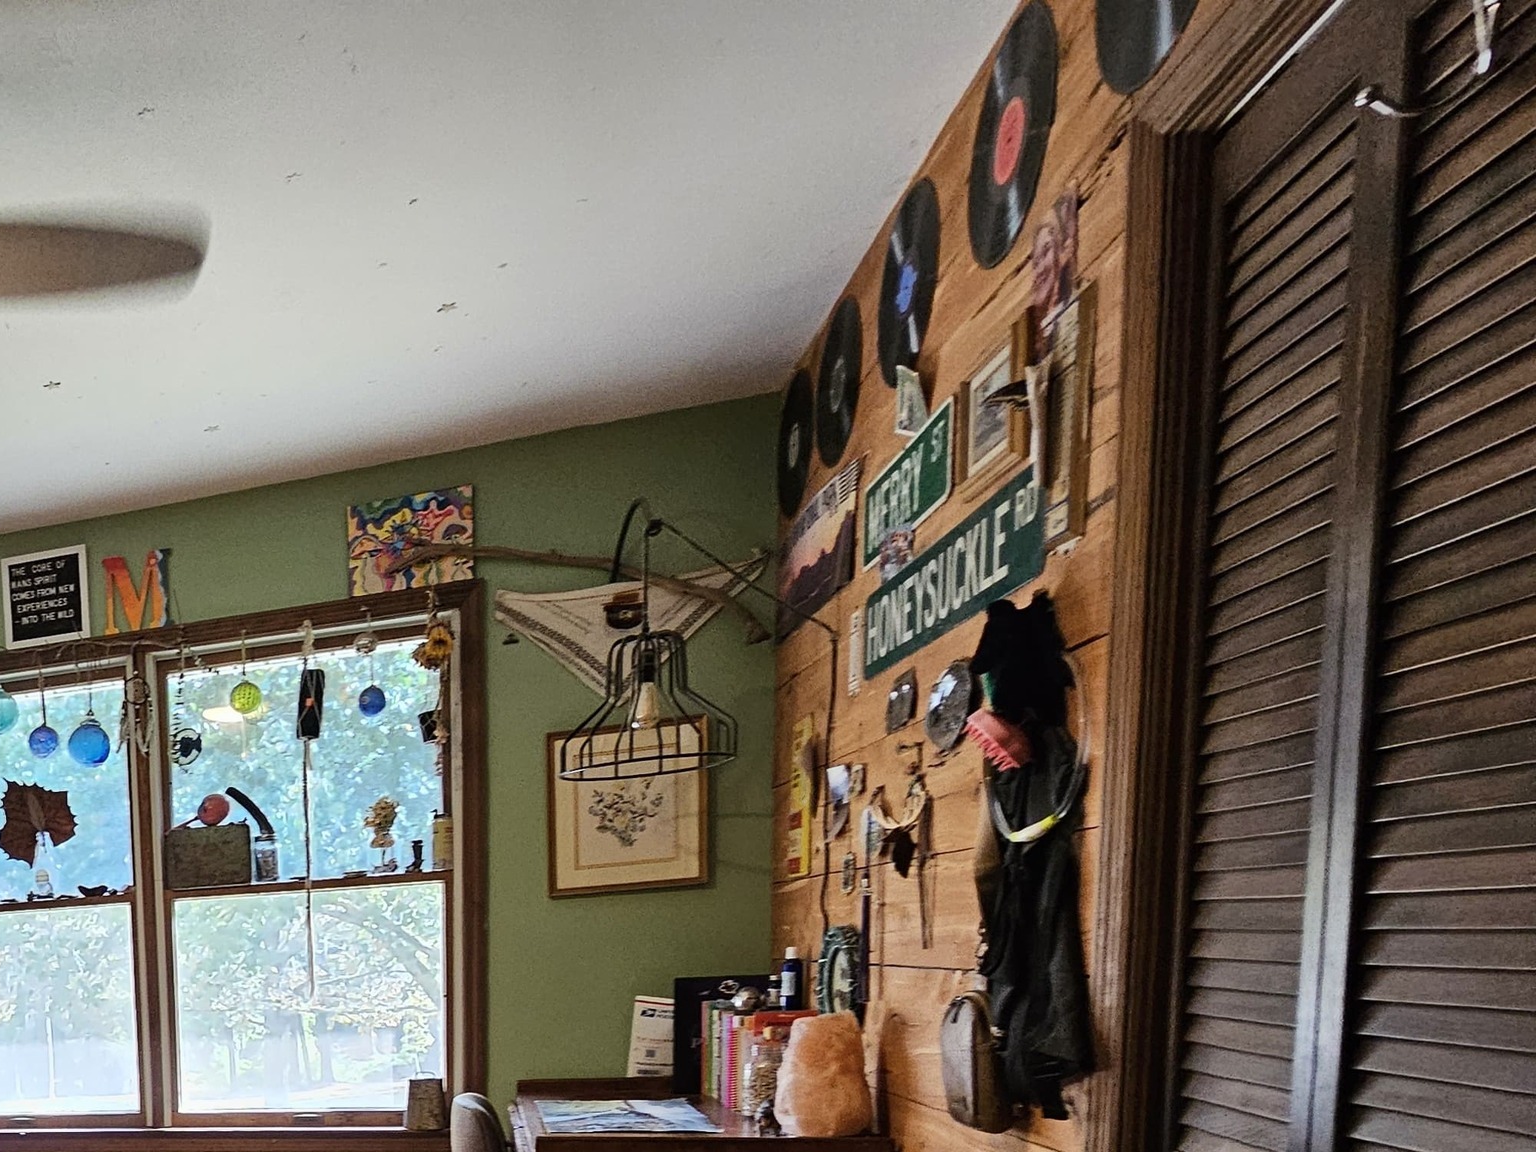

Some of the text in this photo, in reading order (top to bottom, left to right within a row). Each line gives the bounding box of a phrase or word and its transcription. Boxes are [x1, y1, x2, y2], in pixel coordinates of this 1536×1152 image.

[868, 419, 946, 554] MERRY ST
[11, 560, 66, 576] THE CORE OF
[866, 499, 1011, 666] HONEYSUCKLE
[1014, 480, 1037, 531] RD
[34, 574, 58, 586] SPIRIT
[11, 584, 75, 601] COMES FROM NEW
[103, 549, 171, 636] M
[17, 597, 68, 613] EXPERIENCES
[41, 612, 56, 622] THE
[57, 609, 75, 619] WILD
